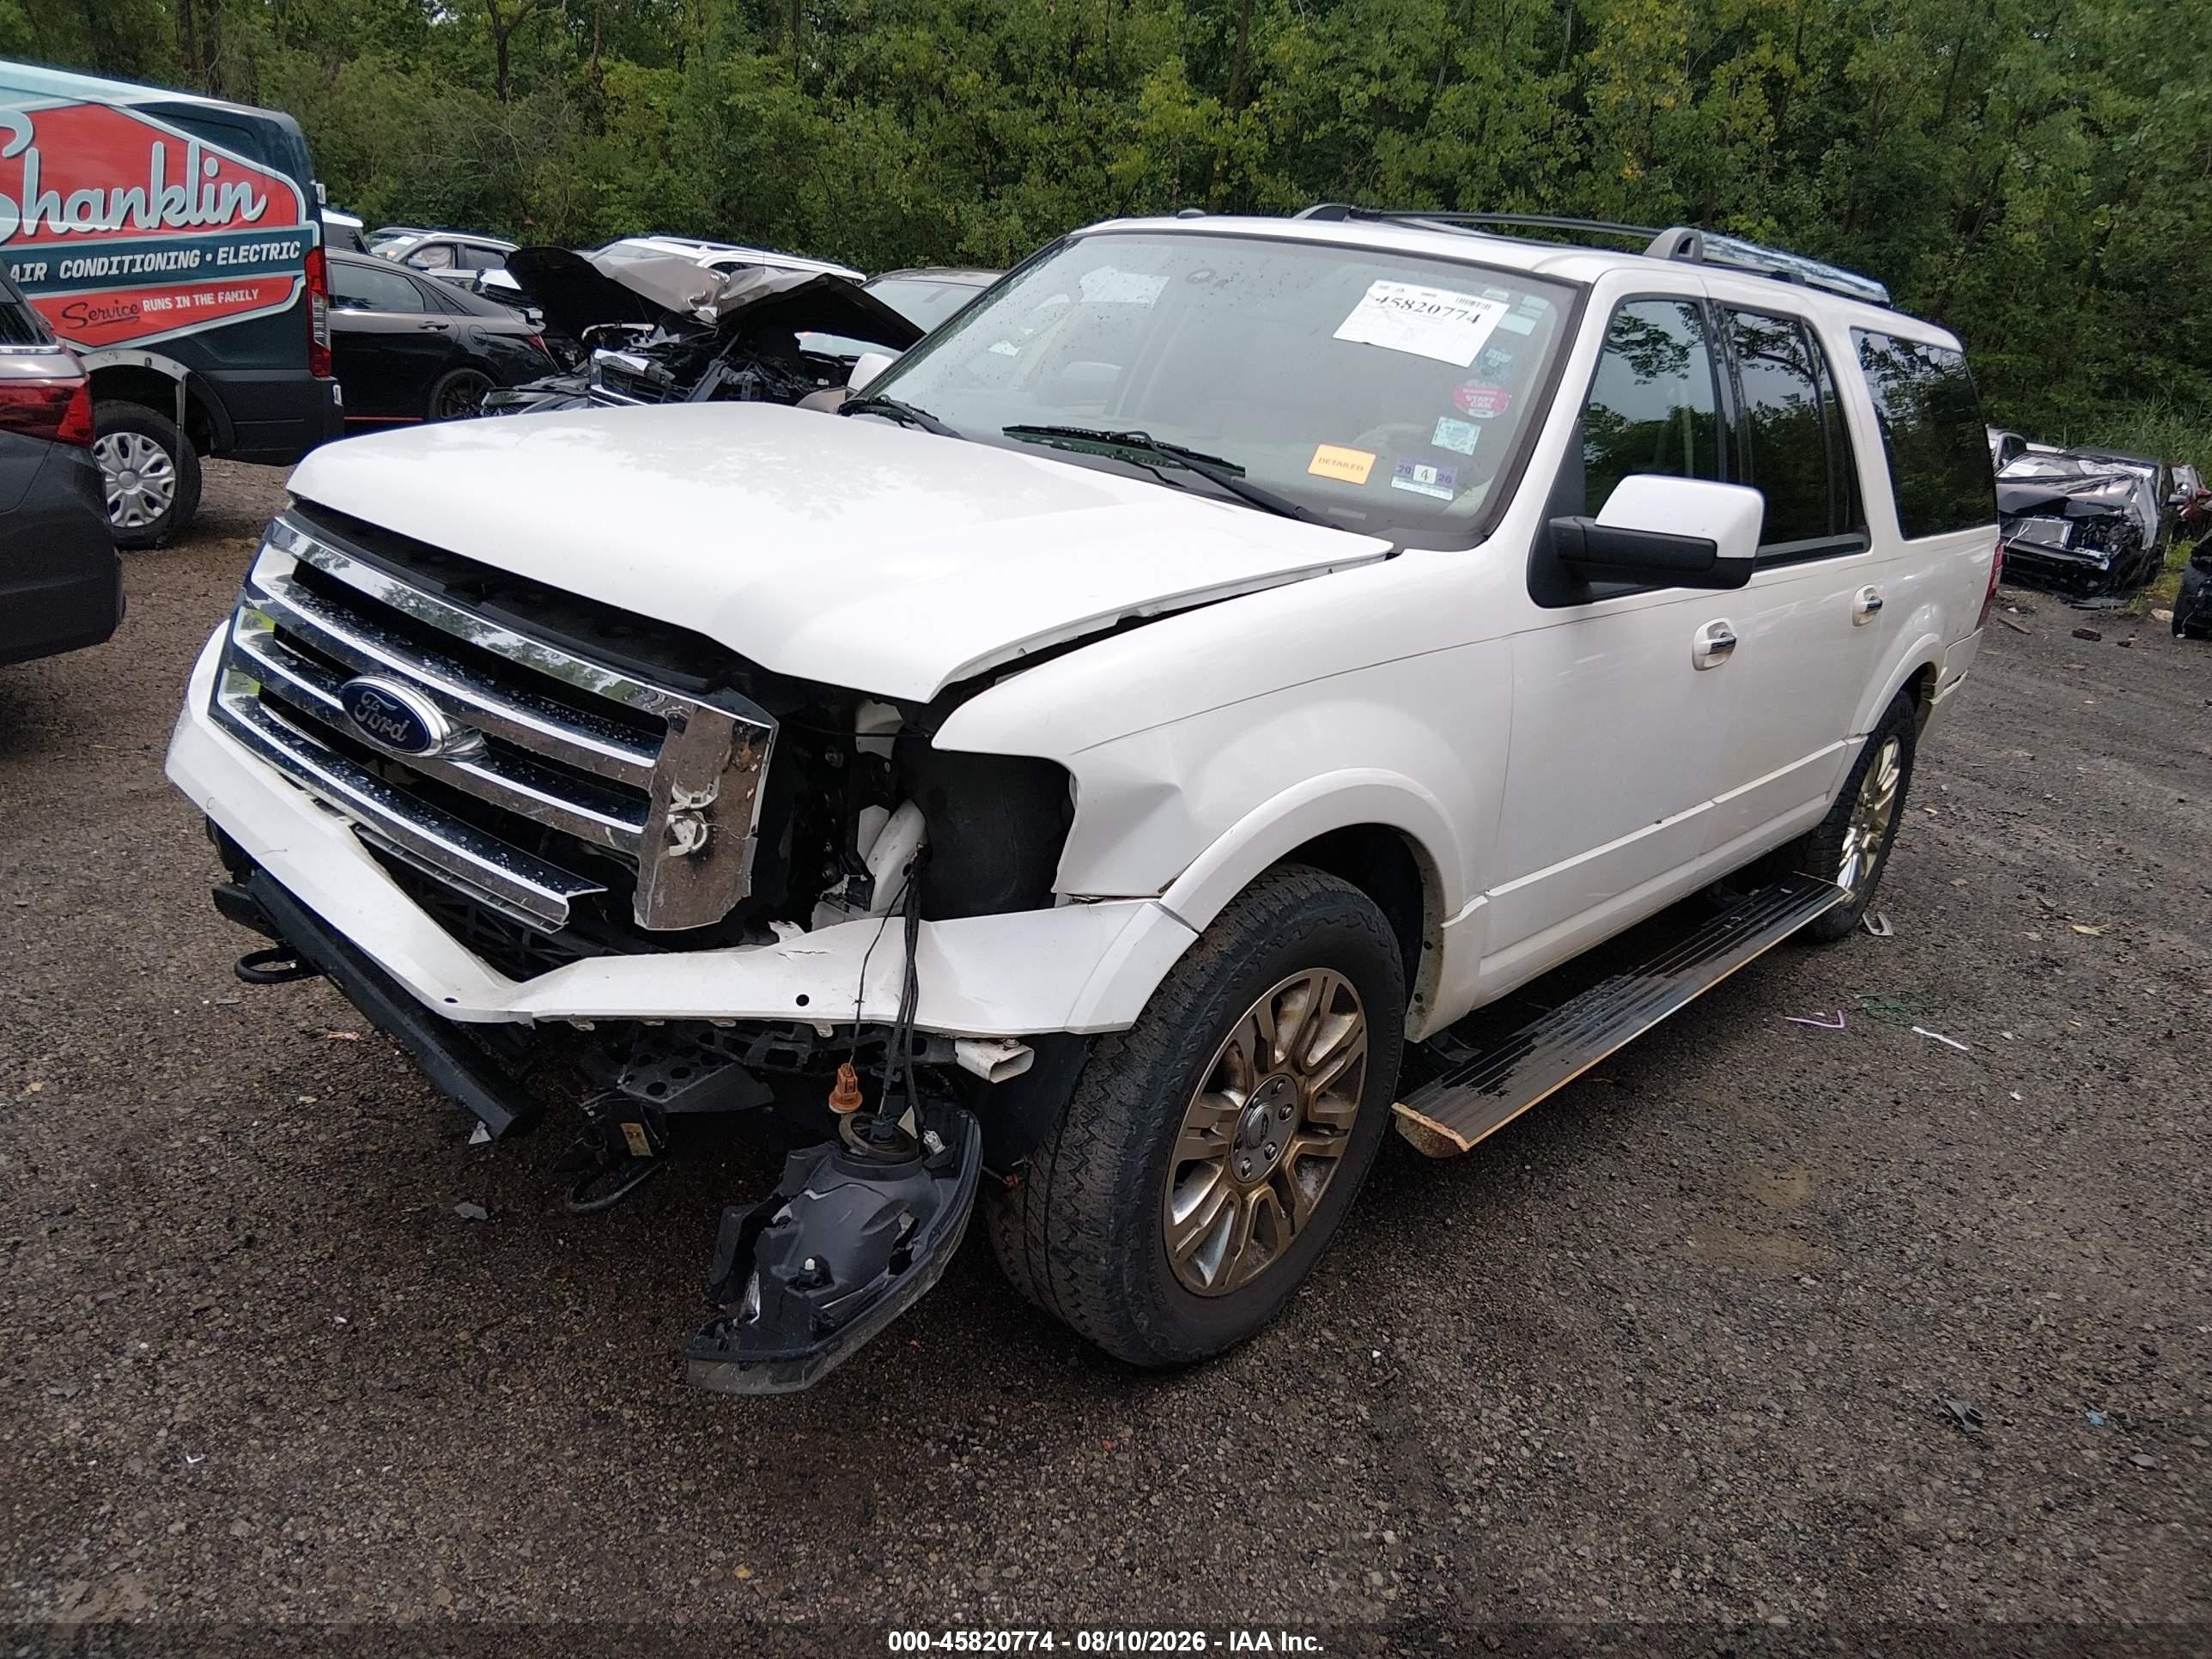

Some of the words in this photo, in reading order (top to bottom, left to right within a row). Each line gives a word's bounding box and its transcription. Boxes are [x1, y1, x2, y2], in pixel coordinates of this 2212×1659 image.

[9, 262, 47, 283] AIR
[59, 249, 201, 280] CONDITIONING
[216, 240, 301, 266] ELECTRIC
[62, 300, 141, 329] Service
[143, 292, 173, 312] RUNS
[175, 295, 191, 308] IN
[192, 292, 215, 307] THE
[217, 288, 259, 304] FAMILY
[1375, 295, 1481, 324] 45820774
[1318, 457, 1364, 471] DETAILED
[354, 691, 410, 743] Ford
